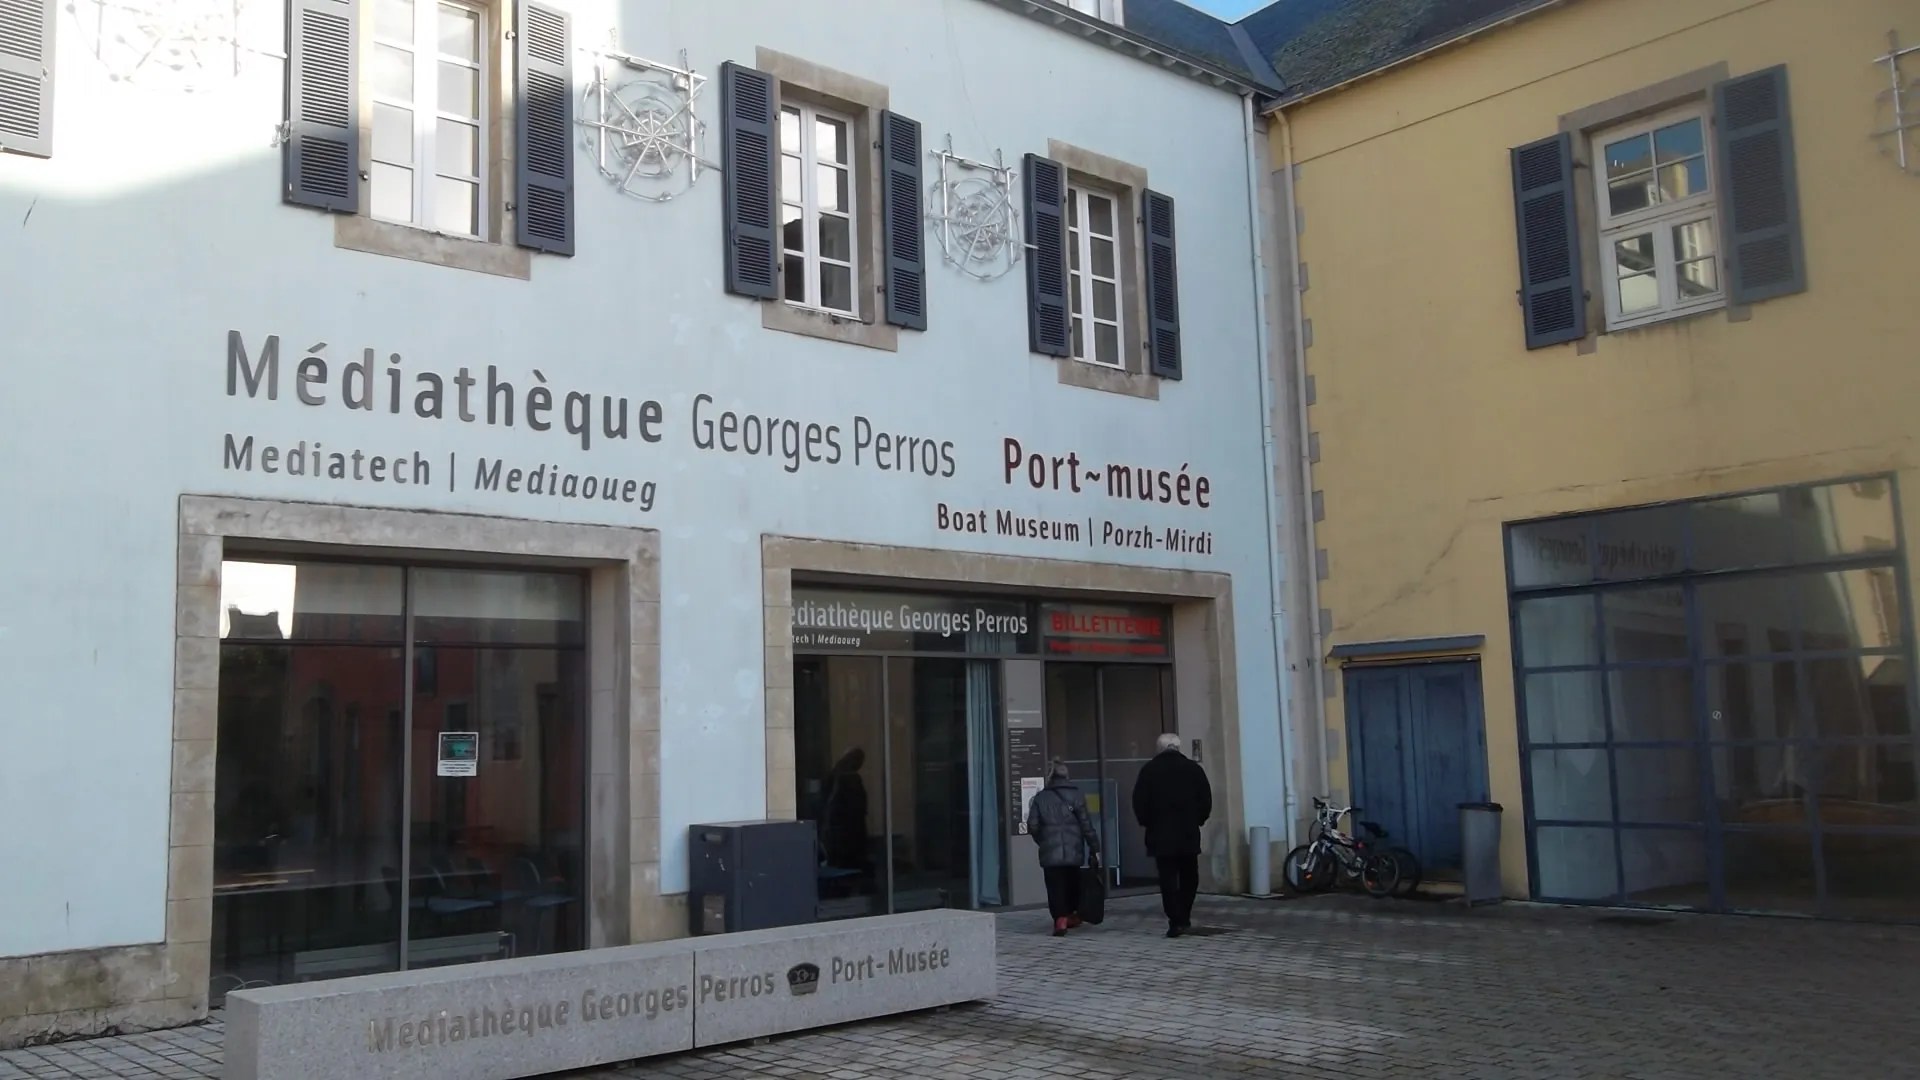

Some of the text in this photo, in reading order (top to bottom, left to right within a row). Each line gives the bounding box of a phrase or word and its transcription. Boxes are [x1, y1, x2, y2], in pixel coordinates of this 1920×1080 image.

[226, 330, 956, 478] Médiathèque Georges Perros
[223, 433, 431, 486] Mediatech
[474, 457, 657, 512] Mediaoueg
[937, 503, 988, 534] Boat
[996, 509, 1080, 542] Museum
[1103, 521, 1212, 555] Porzh-Mirdi
[900, 605, 971, 638] Georges
[975, 608, 1028, 635] Perros
[368, 942, 950, 1054] Médiathèque Georges Perros Port-Musée
